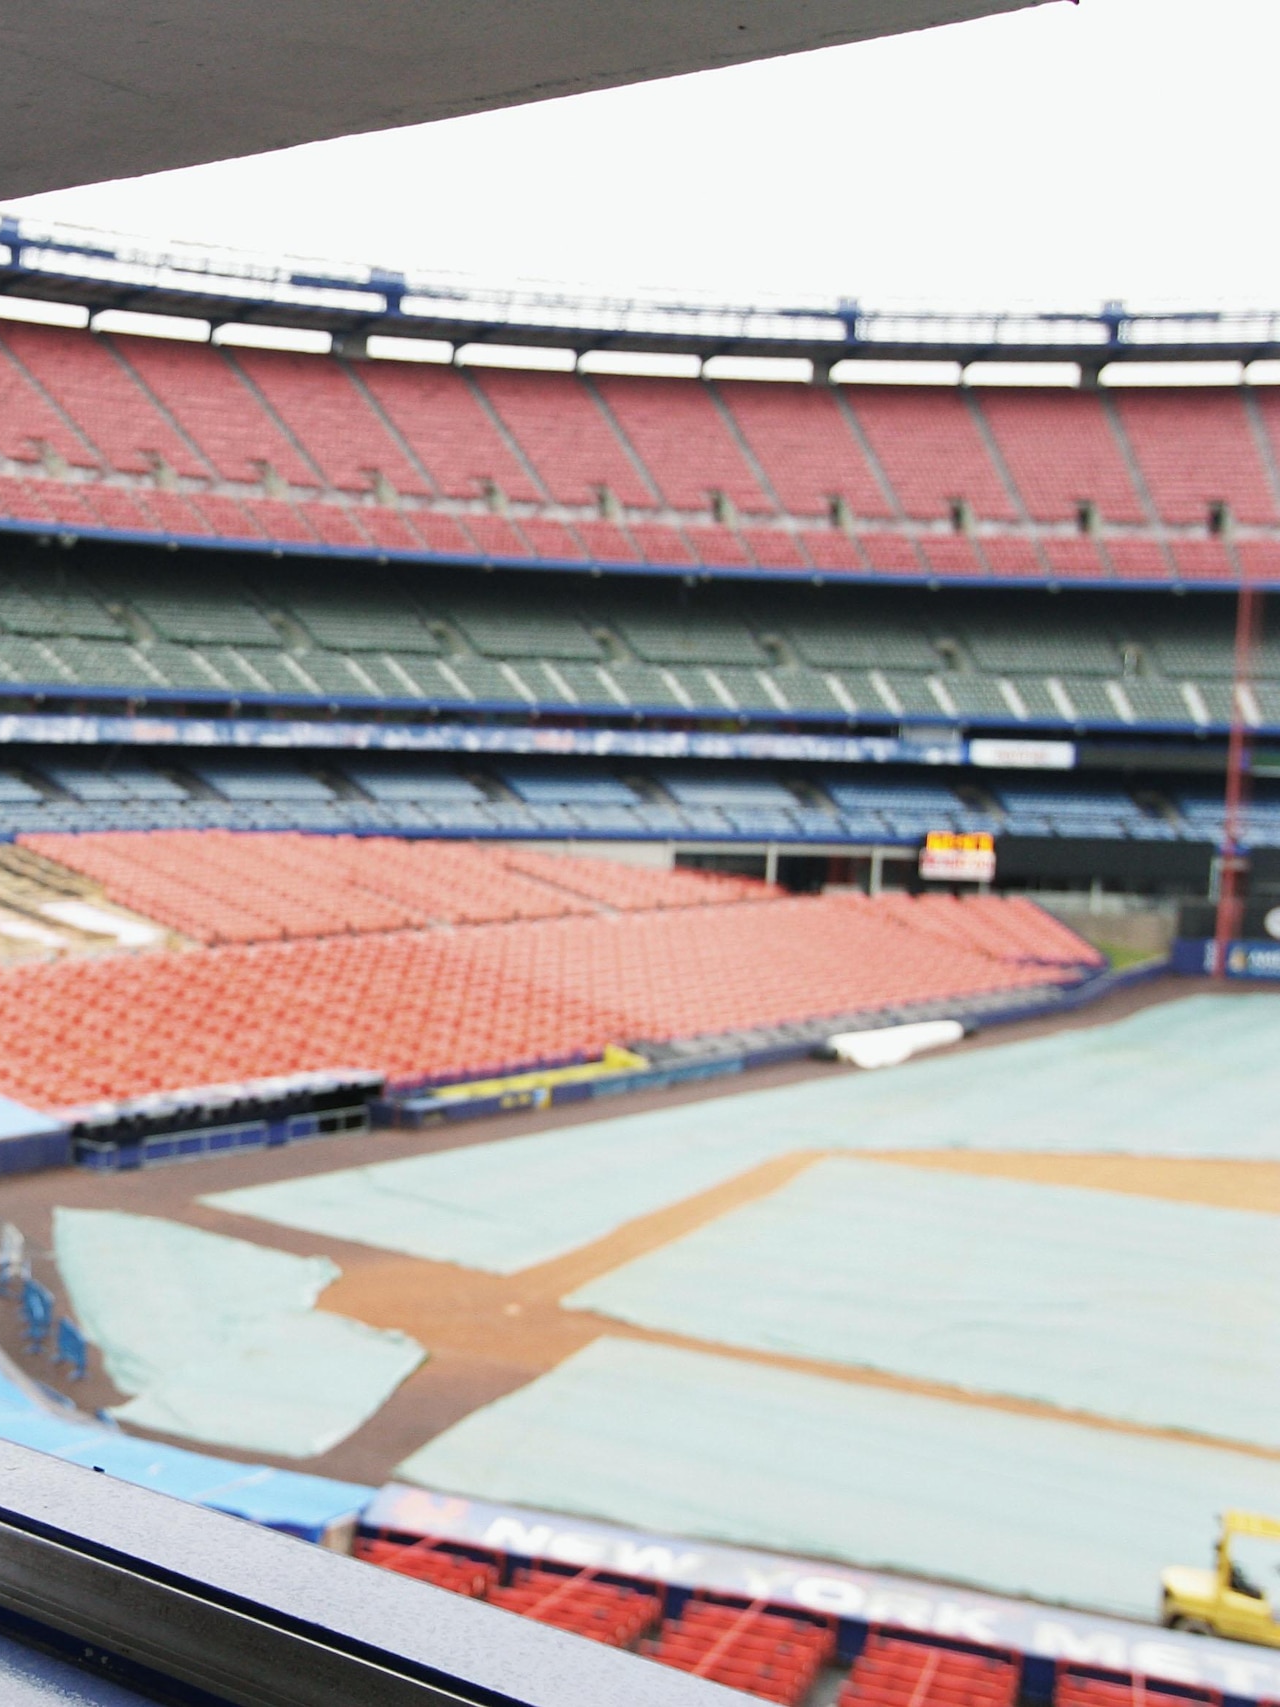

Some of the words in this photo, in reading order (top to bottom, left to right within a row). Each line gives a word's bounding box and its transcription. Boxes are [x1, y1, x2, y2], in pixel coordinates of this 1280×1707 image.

[483, 1516, 708, 1577] NEW
[742, 1565, 1000, 1646] YORK
[1033, 1619, 1280, 1695] MET
